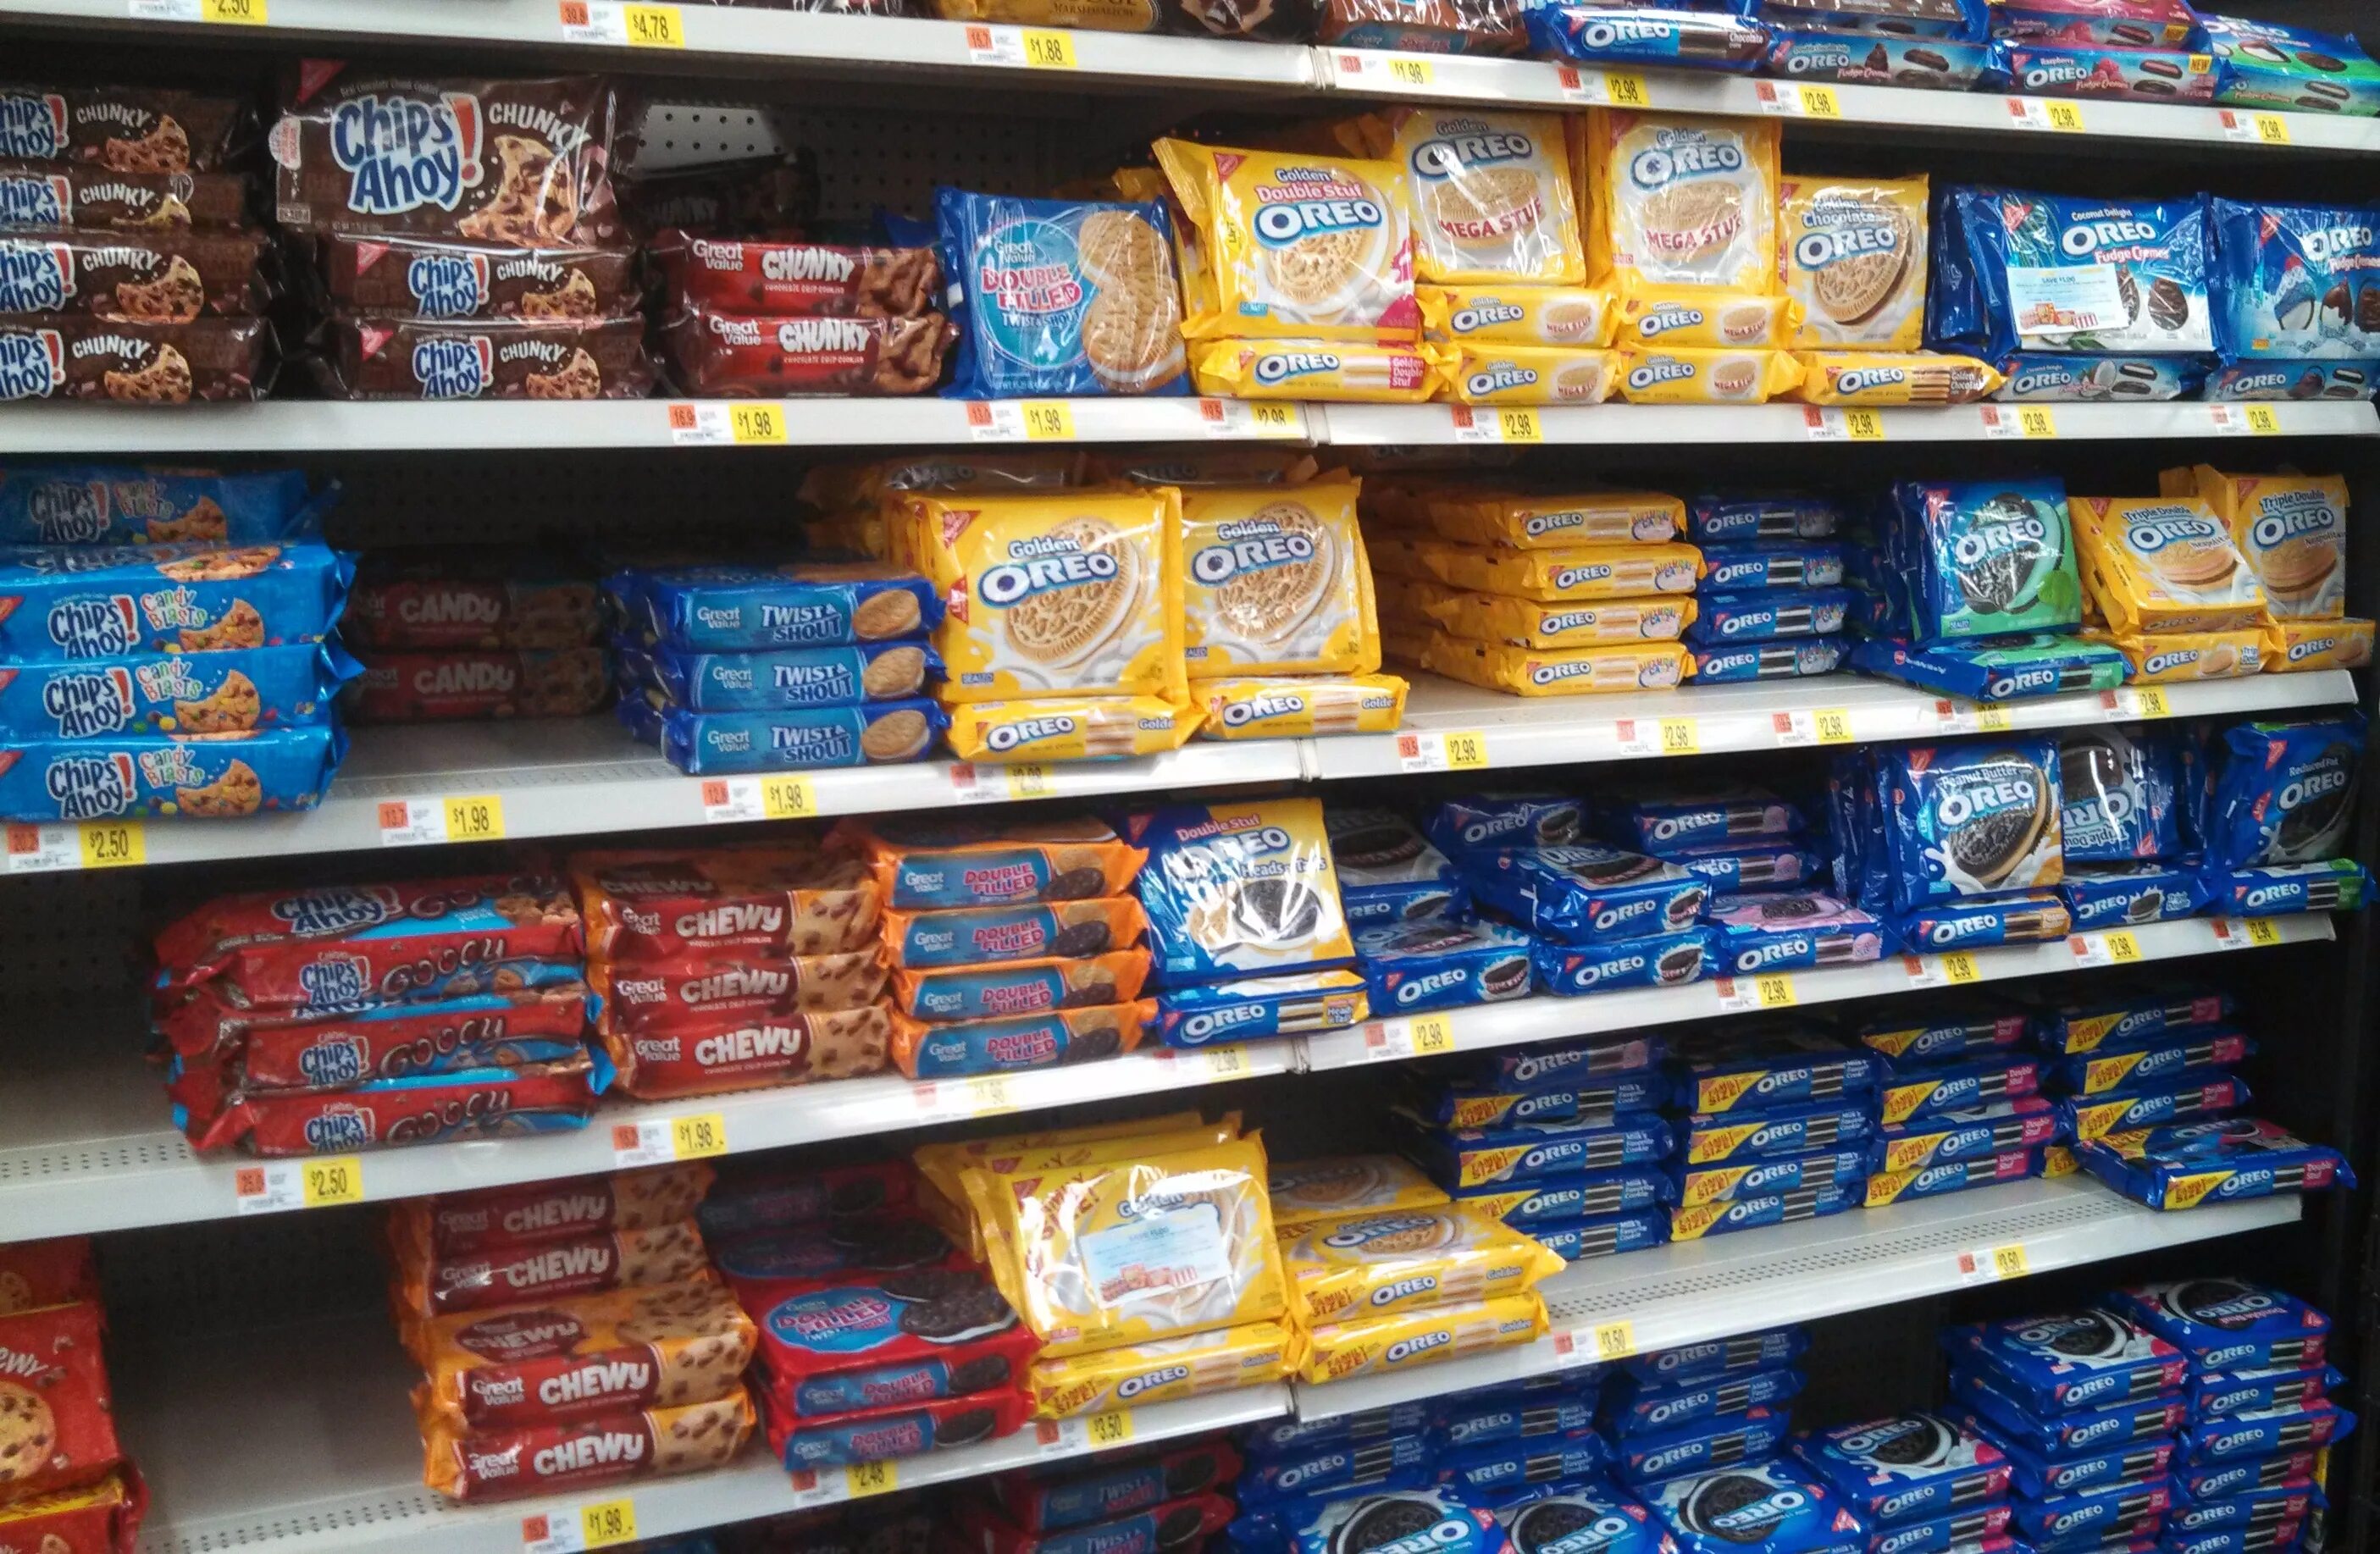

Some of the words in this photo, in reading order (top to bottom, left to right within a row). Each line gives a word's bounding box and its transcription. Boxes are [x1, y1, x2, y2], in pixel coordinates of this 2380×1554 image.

[634, 14, 669, 40] $4.78
[1031, 38, 1063, 62] $1.88
[2191, 58, 2211, 73] NEW
[1613, 77, 1638, 100] $2.98
[1806, 93, 1830, 112] $2.98
[76, 103, 152, 128] CHUNKY
[1436, 120, 1488, 135] Golden
[335, 98, 455, 168] Chips
[1657, 129, 1707, 144] Golden
[1276, 169, 1332, 183] Golden
[1632, 143, 1741, 187] OREO
[80, 183, 154, 207] CHUNKY
[1255, 185, 1318, 202] Double
[1320, 182, 1364, 199] Stuf
[1257, 201, 1381, 240] OREO
[1440, 218, 1495, 239] MEGA
[1499, 197, 1542, 235] STUF
[1802, 212, 1876, 227] Chocolate
[2071, 208, 2103, 221] Coconut
[2104, 207, 2132, 218] Delight
[1647, 228, 1696, 252] MEGA
[1701, 209, 1741, 246] STUF
[2062, 221, 2156, 254] OREO
[82, 246, 158, 272] CHUNKY
[695, 240, 744, 258] Great
[994, 241, 1035, 255] Great
[1797, 230, 1896, 268] OREO
[2095, 250, 2131, 265] Fudge
[412, 257, 478, 288] Chips
[496, 259, 562, 284] CHUNKY
[706, 257, 743, 271] Value
[762, 247, 855, 282] CHUNKY
[982, 265, 1071, 292] DOUBLE
[997, 283, 1082, 312] FILLED
[710, 315, 760, 334] Great
[1452, 305, 1524, 333] OREO
[72, 335, 150, 359] CHUNKY
[723, 334, 761, 346] Value
[778, 318, 871, 352] CHUNKY
[413, 340, 477, 370] Chips
[500, 340, 566, 362] CHUNKY
[1392, 357, 1424, 367] Golden
[1257, 353, 1340, 380] OREO
[1393, 368, 1423, 377] Double
[1629, 362, 1695, 390] OREO
[1392, 377, 1411, 386] Stuf
[1838, 368, 1904, 392] OREO
[738, 412, 772, 437] $1.98
[1029, 409, 1061, 434] $1.98
[1506, 413, 1532, 436] $2.98
[1850, 413, 1874, 434] $2.98
[2024, 413, 2047, 432] $2.98
[2261, 495, 2294, 511] Triple
[2294, 491, 2325, 503] Double
[1527, 513, 1583, 534] OREO
[2124, 512, 2156, 522] Triple
[1219, 521, 1279, 540] Golden
[1955, 519, 2045, 561] OREO
[2130, 521, 2213, 550] OREO
[1010, 538, 1079, 557] Golden
[1194, 535, 1313, 582] OREO
[982, 554, 1117, 604] OREO
[1556, 564, 1611, 588] OREO
[141, 586, 196, 611] Candy
[399, 594, 501, 623] CANDY
[51, 603, 119, 644] Chips
[697, 607, 740, 621] Great
[708, 618, 740, 629] Value
[762, 606, 823, 627] TWIST
[773, 617, 841, 641] SHOUT
[2289, 637, 2334, 661] OREO
[136, 658, 191, 684] Candy
[414, 662, 515, 694] CANDY
[712, 666, 751, 682] Great
[774, 665, 834, 687] TWIST
[47, 675, 115, 716] Chips
[722, 679, 752, 689] Value
[787, 676, 853, 701] SHOUT
[1225, 696, 1303, 725] OREO
[2139, 692, 2161, 711] $2.98
[707, 730, 750, 745] Great
[772, 727, 831, 749] TWIST
[988, 716, 1075, 751] OREO
[1664, 725, 1689, 748] $2.98
[1819, 716, 1843, 737] $2.98
[140, 747, 195, 769] Candy
[784, 736, 850, 762] SHOUT
[1451, 739, 1477, 762] $2.98
[49, 760, 118, 799] Chips
[1941, 770, 1982, 787] Peanut
[1984, 766, 2019, 781] Butter
[771, 784, 802, 810] $1.98
[1938, 781, 2034, 826] OREO
[454, 806, 490, 835] $1.98
[1176, 821, 1228, 842] Double
[1230, 815, 1260, 829] Stuf
[89, 830, 129, 857] $2.50
[905, 872, 944, 887] Great
[964, 863, 1032, 886] DOUBLE
[973, 874, 1036, 894] FILLED
[2246, 883, 2300, 907] OREO
[675, 904, 783, 937] CHEWY
[1595, 899, 1656, 930] OREO
[915, 932, 954, 946] Great
[973, 919, 1038, 943] DOUBLE
[982, 929, 1045, 952] FILLED
[302, 961, 357, 988] Chips
[1575, 956, 1646, 987] OREO
[1948, 955, 1971, 974] $2.98
[680, 969, 789, 1003] CHEWY
[982, 980, 1049, 1004] DOUBLE
[1398, 969, 1468, 1004] OREO
[1763, 980, 1785, 1000] $2.98
[924, 992, 962, 1006] Great
[990, 991, 1052, 1012] FILLED
[1185, 1004, 1266, 1037] OREO
[636, 1036, 680, 1053] Great
[695, 1026, 801, 1065] CHEWY
[929, 1040, 966, 1055] Great
[987, 1029, 1052, 1053] DOUBLE
[995, 1039, 1056, 1062] FILLED
[302, 1042, 357, 1071] Chips
[1757, 1069, 1807, 1092] OREO
[680, 1123, 712, 1149] $1.98
[1525, 1142, 1582, 1166] OREO
[311, 1169, 347, 1196] $2.50
[503, 1196, 606, 1232] CHEWY
[507, 1247, 610, 1287] CHEWY
[1372, 1276, 1436, 1305] OREO
[1486, 1267, 1521, 1280] Golden
[539, 1363, 650, 1406] CHEWY
[1118, 1367, 1187, 1397] OREO
[2065, 1376, 2115, 1407] OREO
[1650, 1393, 1709, 1424] OREO
[1094, 1416, 1122, 1439] $3.50
[2069, 1418, 2120, 1447] OREO
[534, 1432, 644, 1475] CHEWY
[2215, 1429, 2264, 1456] OREO
[1278, 1455, 1346, 1488] OREO
[1642, 1444, 1703, 1474] OREO
[1880, 1487, 1934, 1516] OREO
[589, 1508, 623, 1537] $1.98
[2056, 1504, 2103, 1535] OREO
